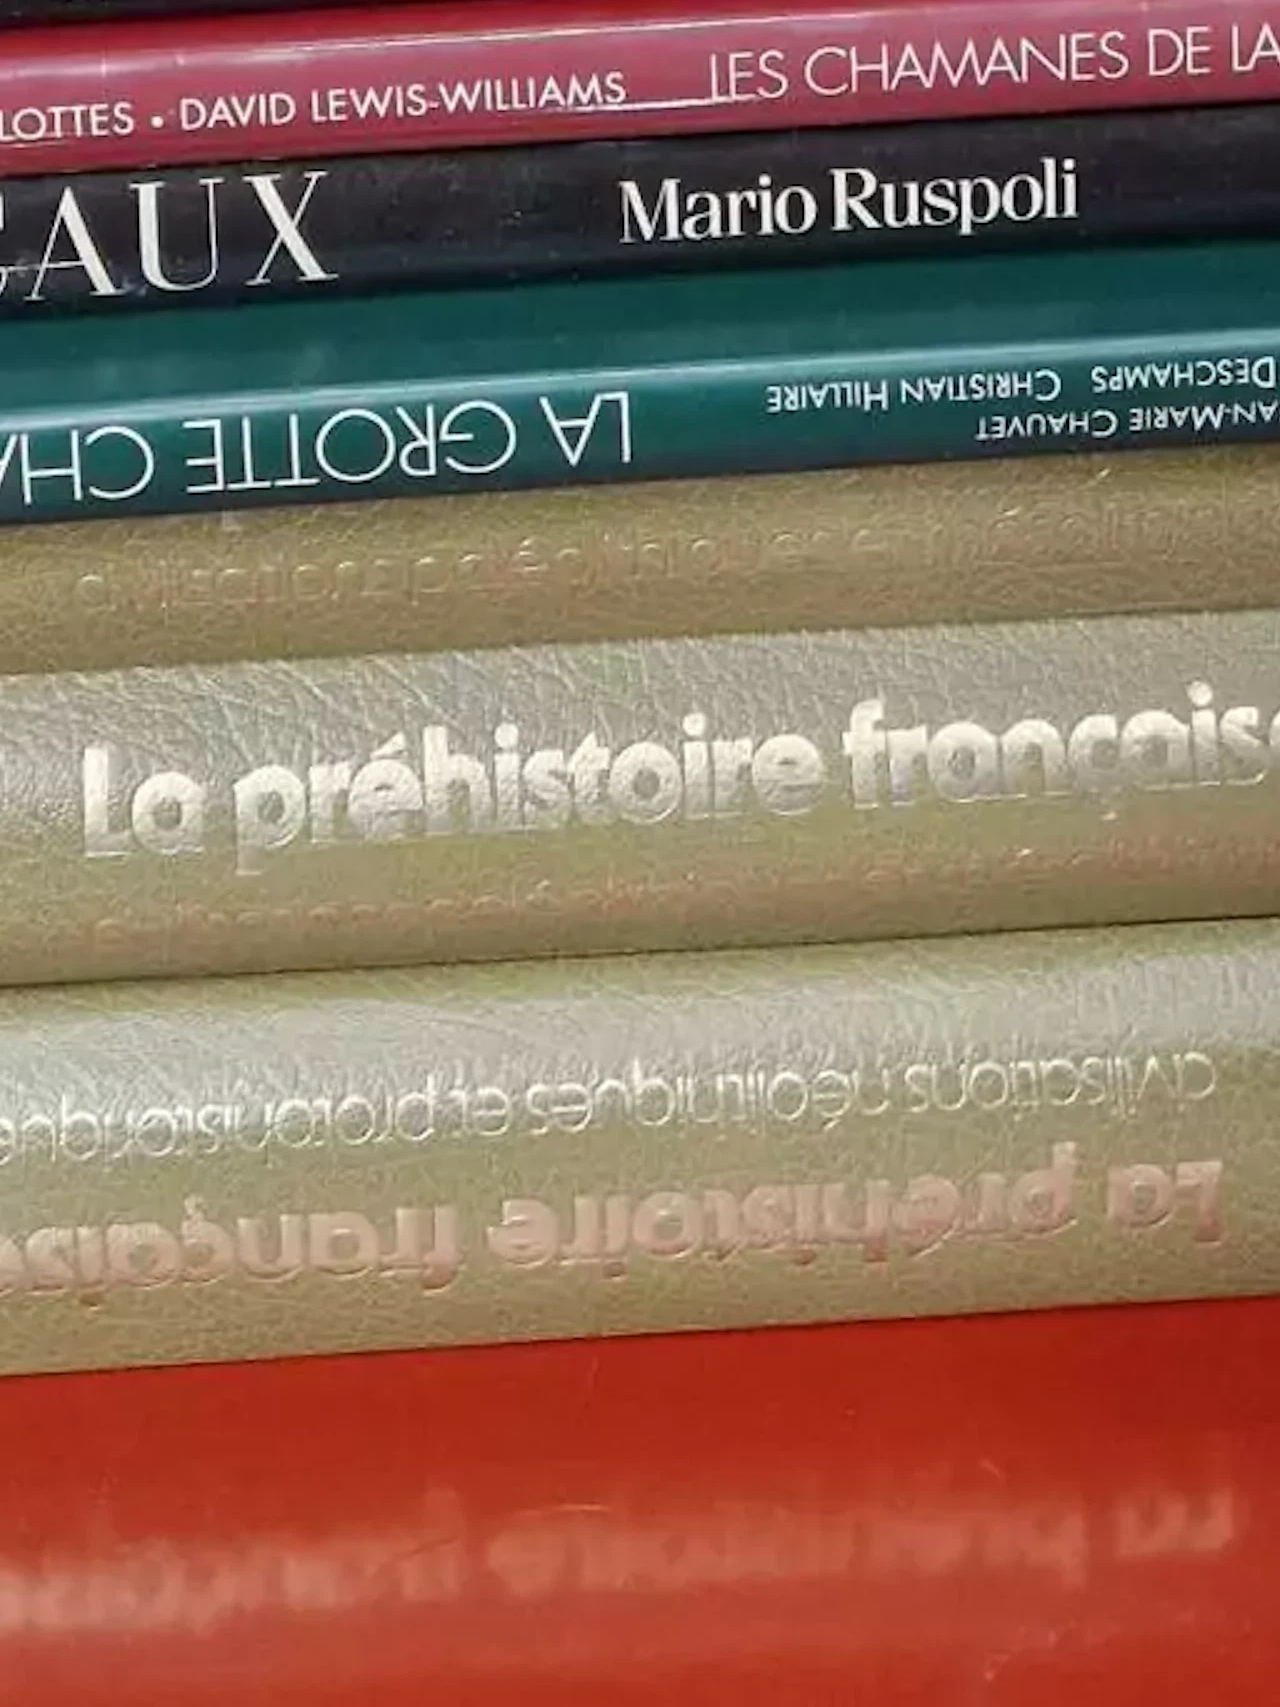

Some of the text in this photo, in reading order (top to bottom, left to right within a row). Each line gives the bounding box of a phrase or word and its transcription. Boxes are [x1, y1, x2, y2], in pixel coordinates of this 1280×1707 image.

[180, 92, 294, 127] DAVID
[311, 71, 627, 122] LEWIS-WILLIAMS
[709, 53, 787, 101] LES
[806, 31, 1129, 99] CHAMANES
[1148, 29, 1215, 77] DE
[619, 161, 817, 241] Mario
[835, 157, 1078, 238] Ruspoli
[767, 377, 889, 414] HILLAIRE
[892, 367, 1063, 403] CHRISTIAN
[1091, 356, 1276, 395] DESCHAMPS
[183, 401, 517, 494] GROTTE
[539, 389, 630, 464] LA
[974, 408, 1117, 440] CHAUVET
[84, 746, 204, 857] La
[234, 713, 817, 877] préhistoire
[908, 1051, 1215, 1114] civilisations
[491, 1142, 1077, 1283] préhistoire
[1107, 1159, 1220, 1245] La
